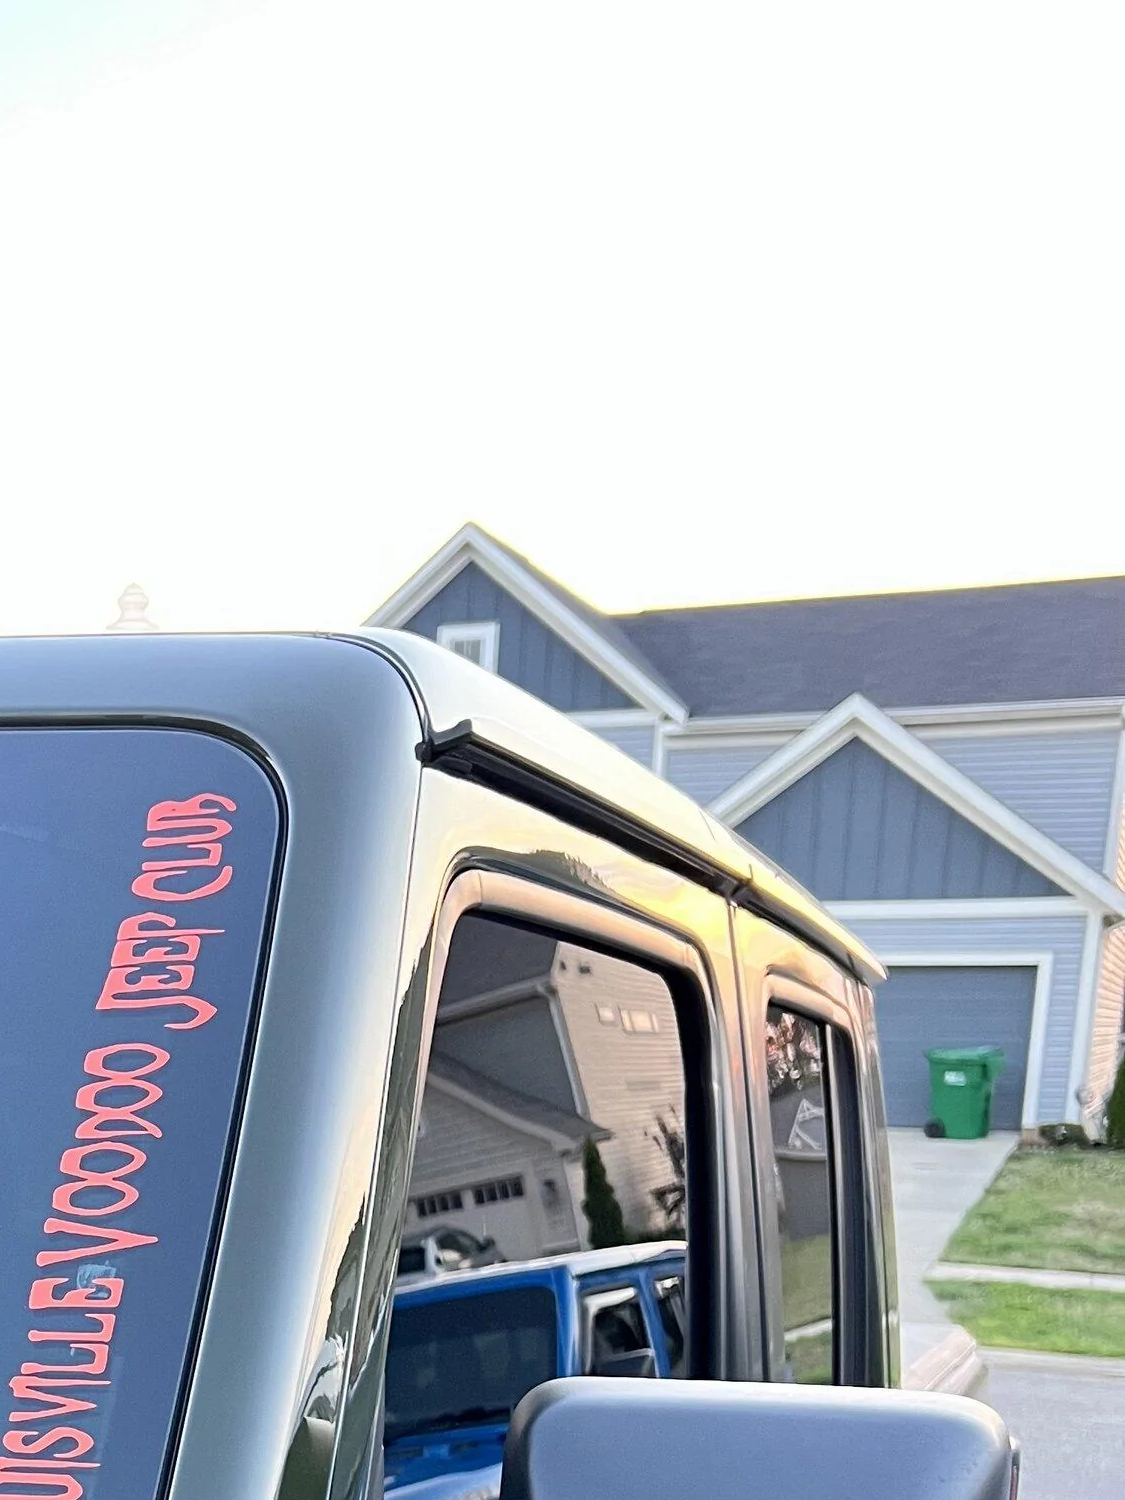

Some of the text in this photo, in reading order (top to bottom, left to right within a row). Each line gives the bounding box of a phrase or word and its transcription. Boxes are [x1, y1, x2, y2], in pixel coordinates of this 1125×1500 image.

[132, 793, 236, 902] CLUB
[96, 912, 225, 1030] JEEP
[36, 1043, 169, 1266] VOODOO
